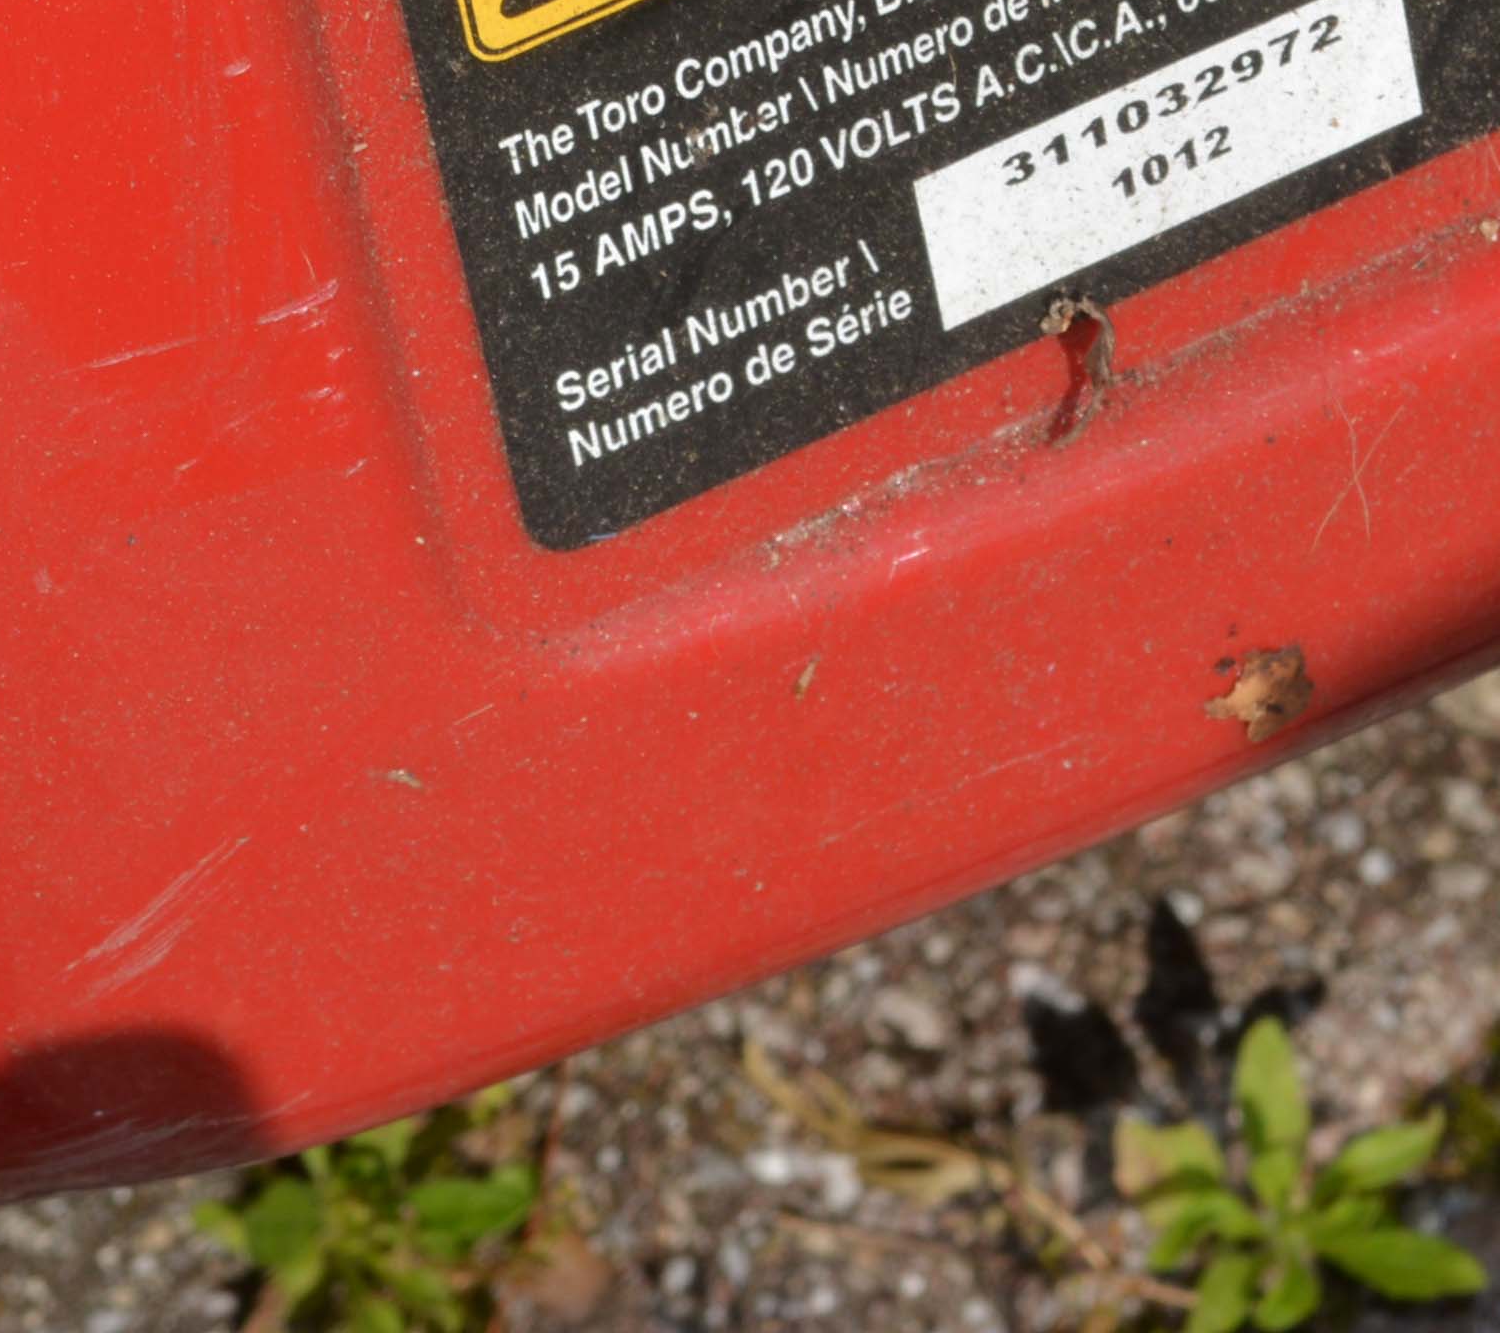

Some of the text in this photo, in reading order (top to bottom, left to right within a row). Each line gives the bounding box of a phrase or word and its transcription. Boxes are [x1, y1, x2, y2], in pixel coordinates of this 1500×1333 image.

[498, 124, 574, 175] The
[576, 84, 666, 140] Toro
[515, 155, 633, 239] Model
[640, 92, 792, 184] Number
[822, 16, 974, 104] Numero
[1001, 14, 1342, 186] 311032972
[1112, 126, 1232, 198] 1012
[531, 250, 581, 299] 15
[596, 189, 732, 276] AMPS,
[741, 148, 814, 206] 120
[819, 82, 961, 170] VOLTS
[556, 328, 676, 411] Serial
[686, 256, 850, 354] Number
[568, 290, 912, 467] Numero de Série
